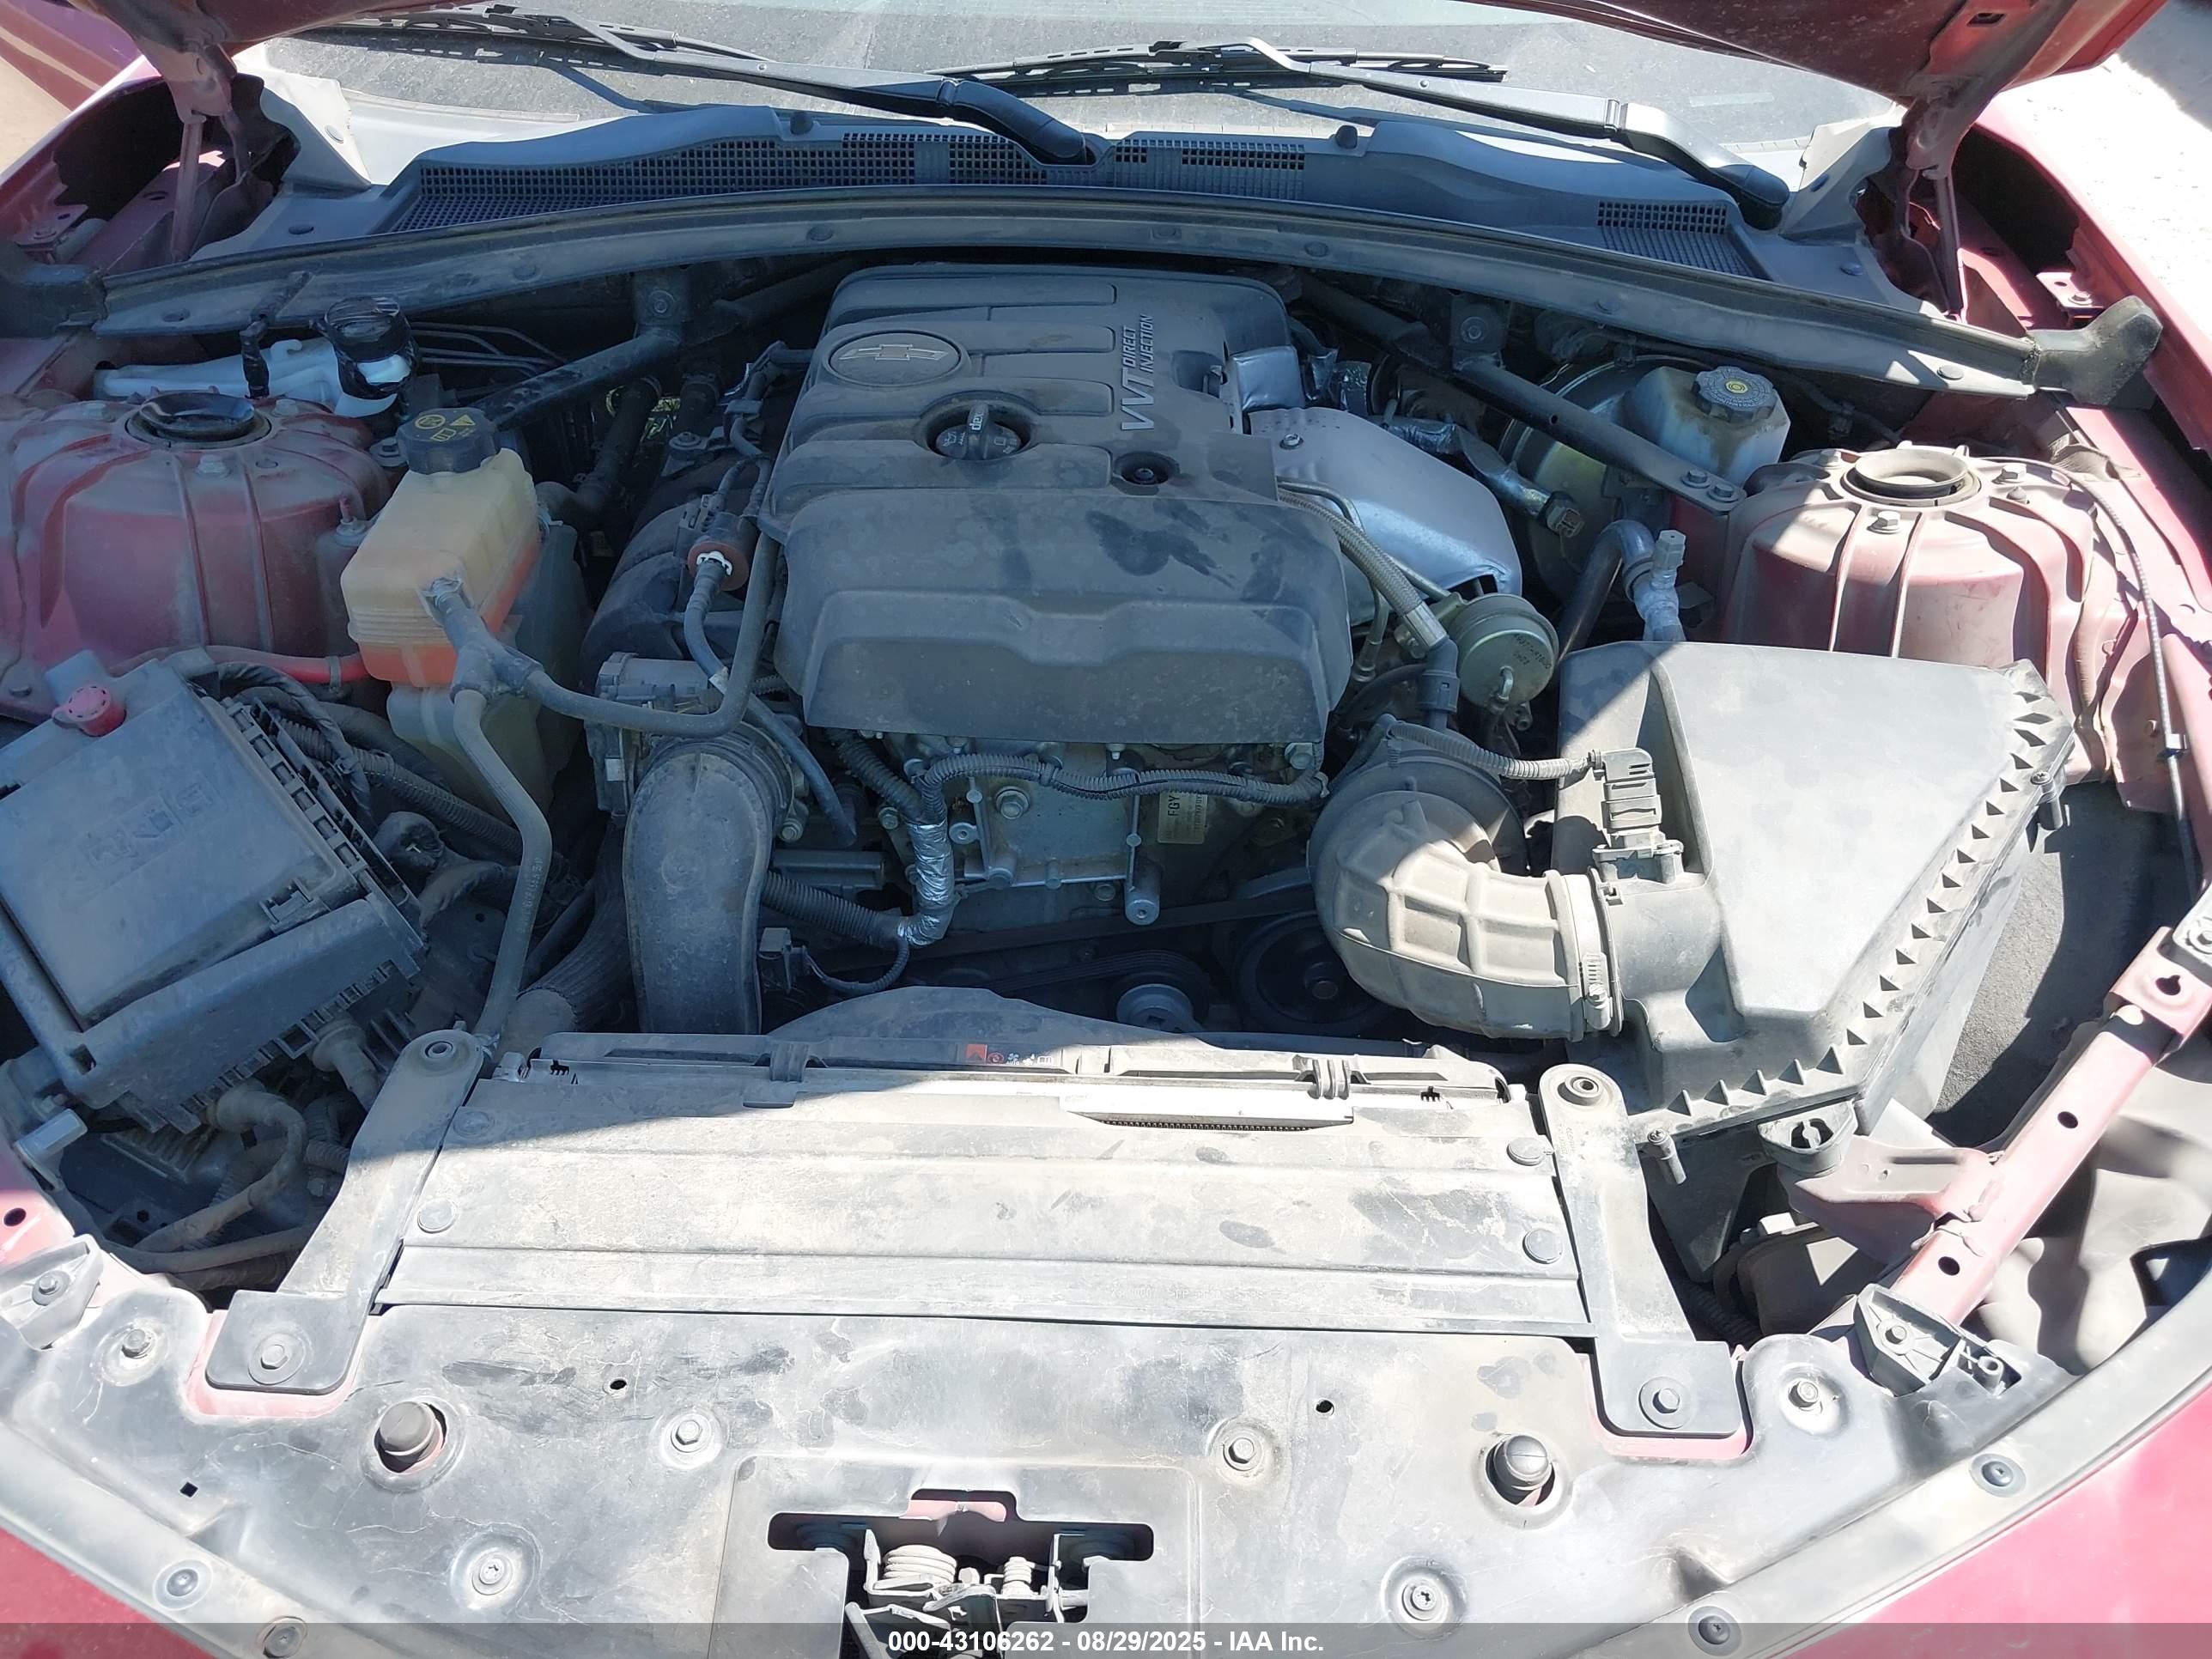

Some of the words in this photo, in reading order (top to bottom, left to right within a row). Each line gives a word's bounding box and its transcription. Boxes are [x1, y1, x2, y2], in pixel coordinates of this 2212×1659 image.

[1123, 325, 1136, 368] DIRECT
[1139, 313, 1154, 374] INJECTION
[1121, 368, 1155, 430] VVT
[1168, 795, 1181, 817] FGY
